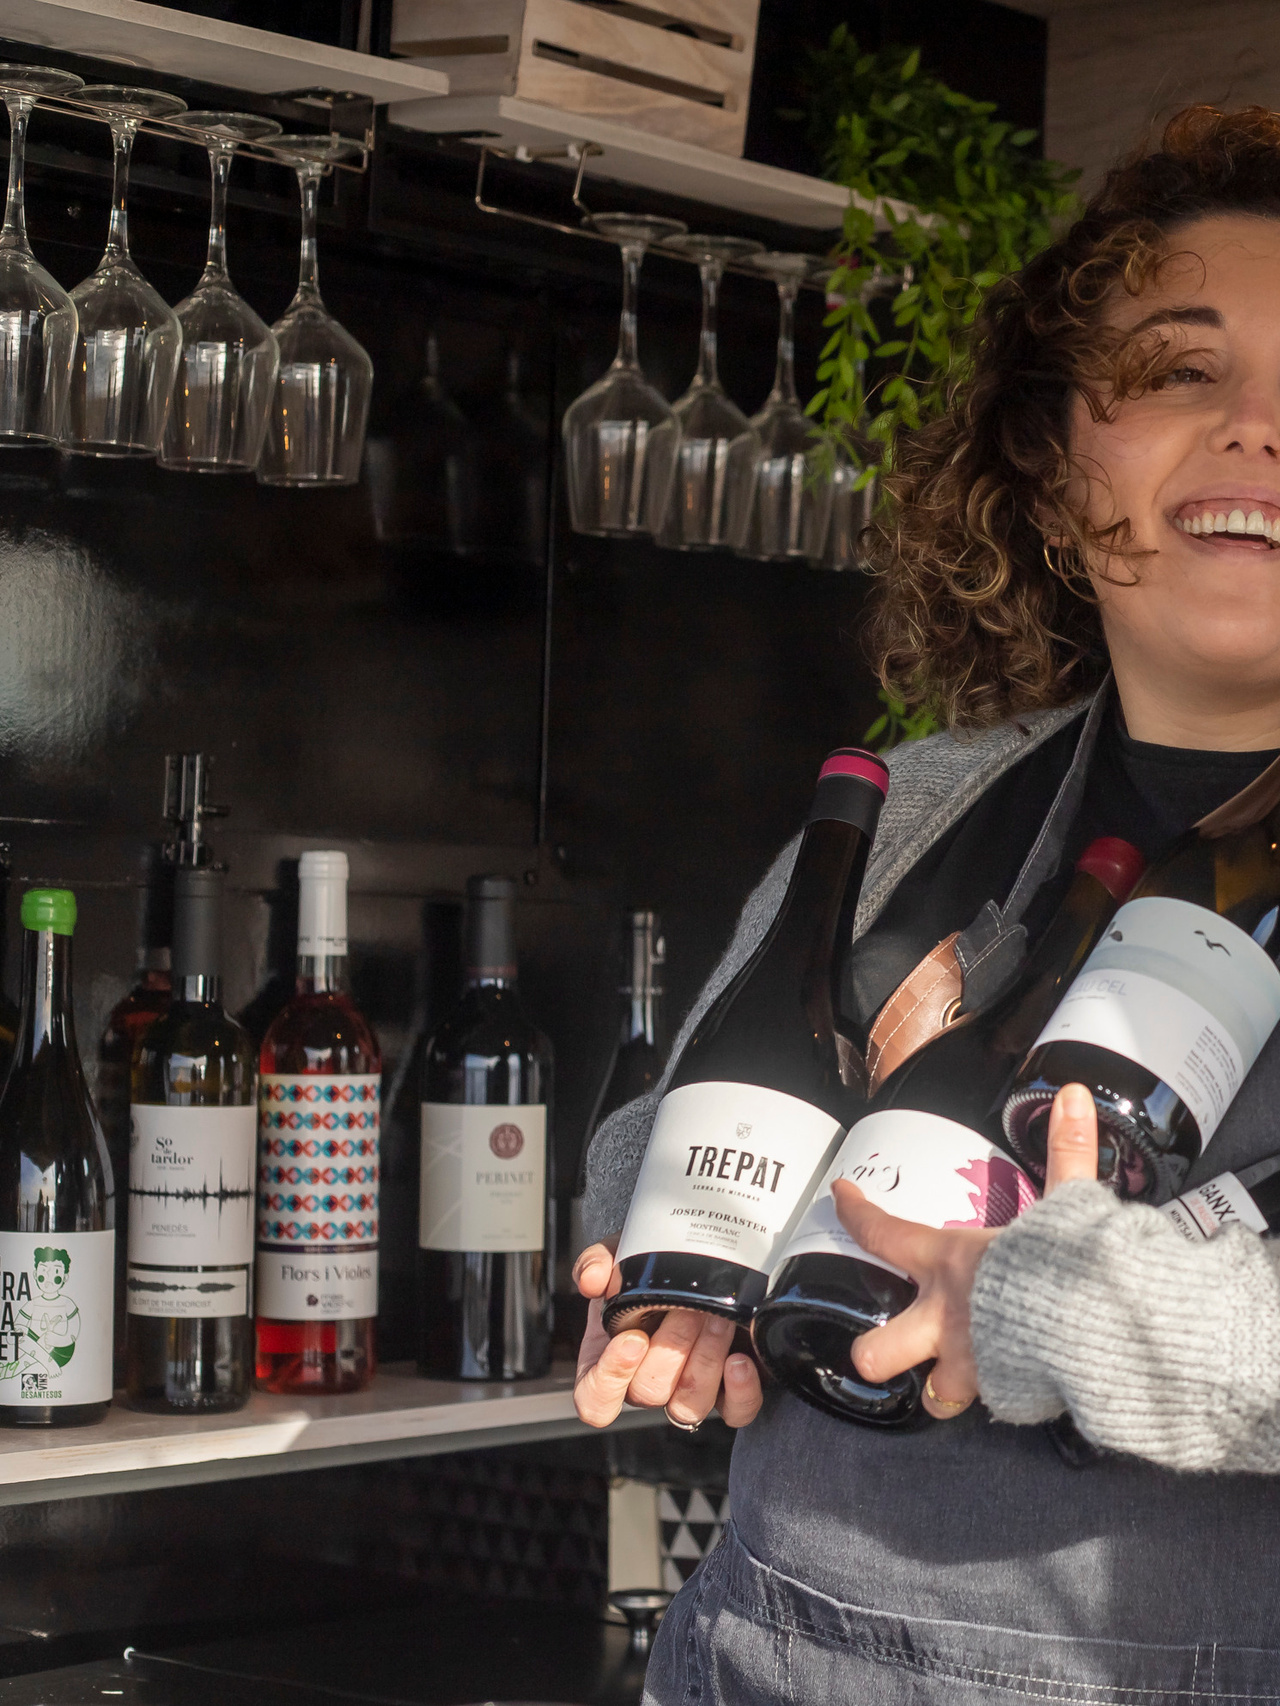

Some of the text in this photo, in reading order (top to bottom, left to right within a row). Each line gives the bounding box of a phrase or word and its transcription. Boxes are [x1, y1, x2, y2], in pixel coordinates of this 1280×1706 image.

[155, 1136, 173, 1151] So
[151, 1152, 194, 1165] tardor
[685, 1145, 785, 1193] TREPAT
[692, 1184, 714, 1192] SERRA
[670, 1207, 767, 1234] JOSEP FORASTER
[690, 1222, 741, 1238] MONTBLANC
[281, 1265, 320, 1281] Flors
[325, 1265, 329, 1281] i
[38, 1373, 48, 1391] VINS
[20, 1390, 63, 1399] DESANTESOS
